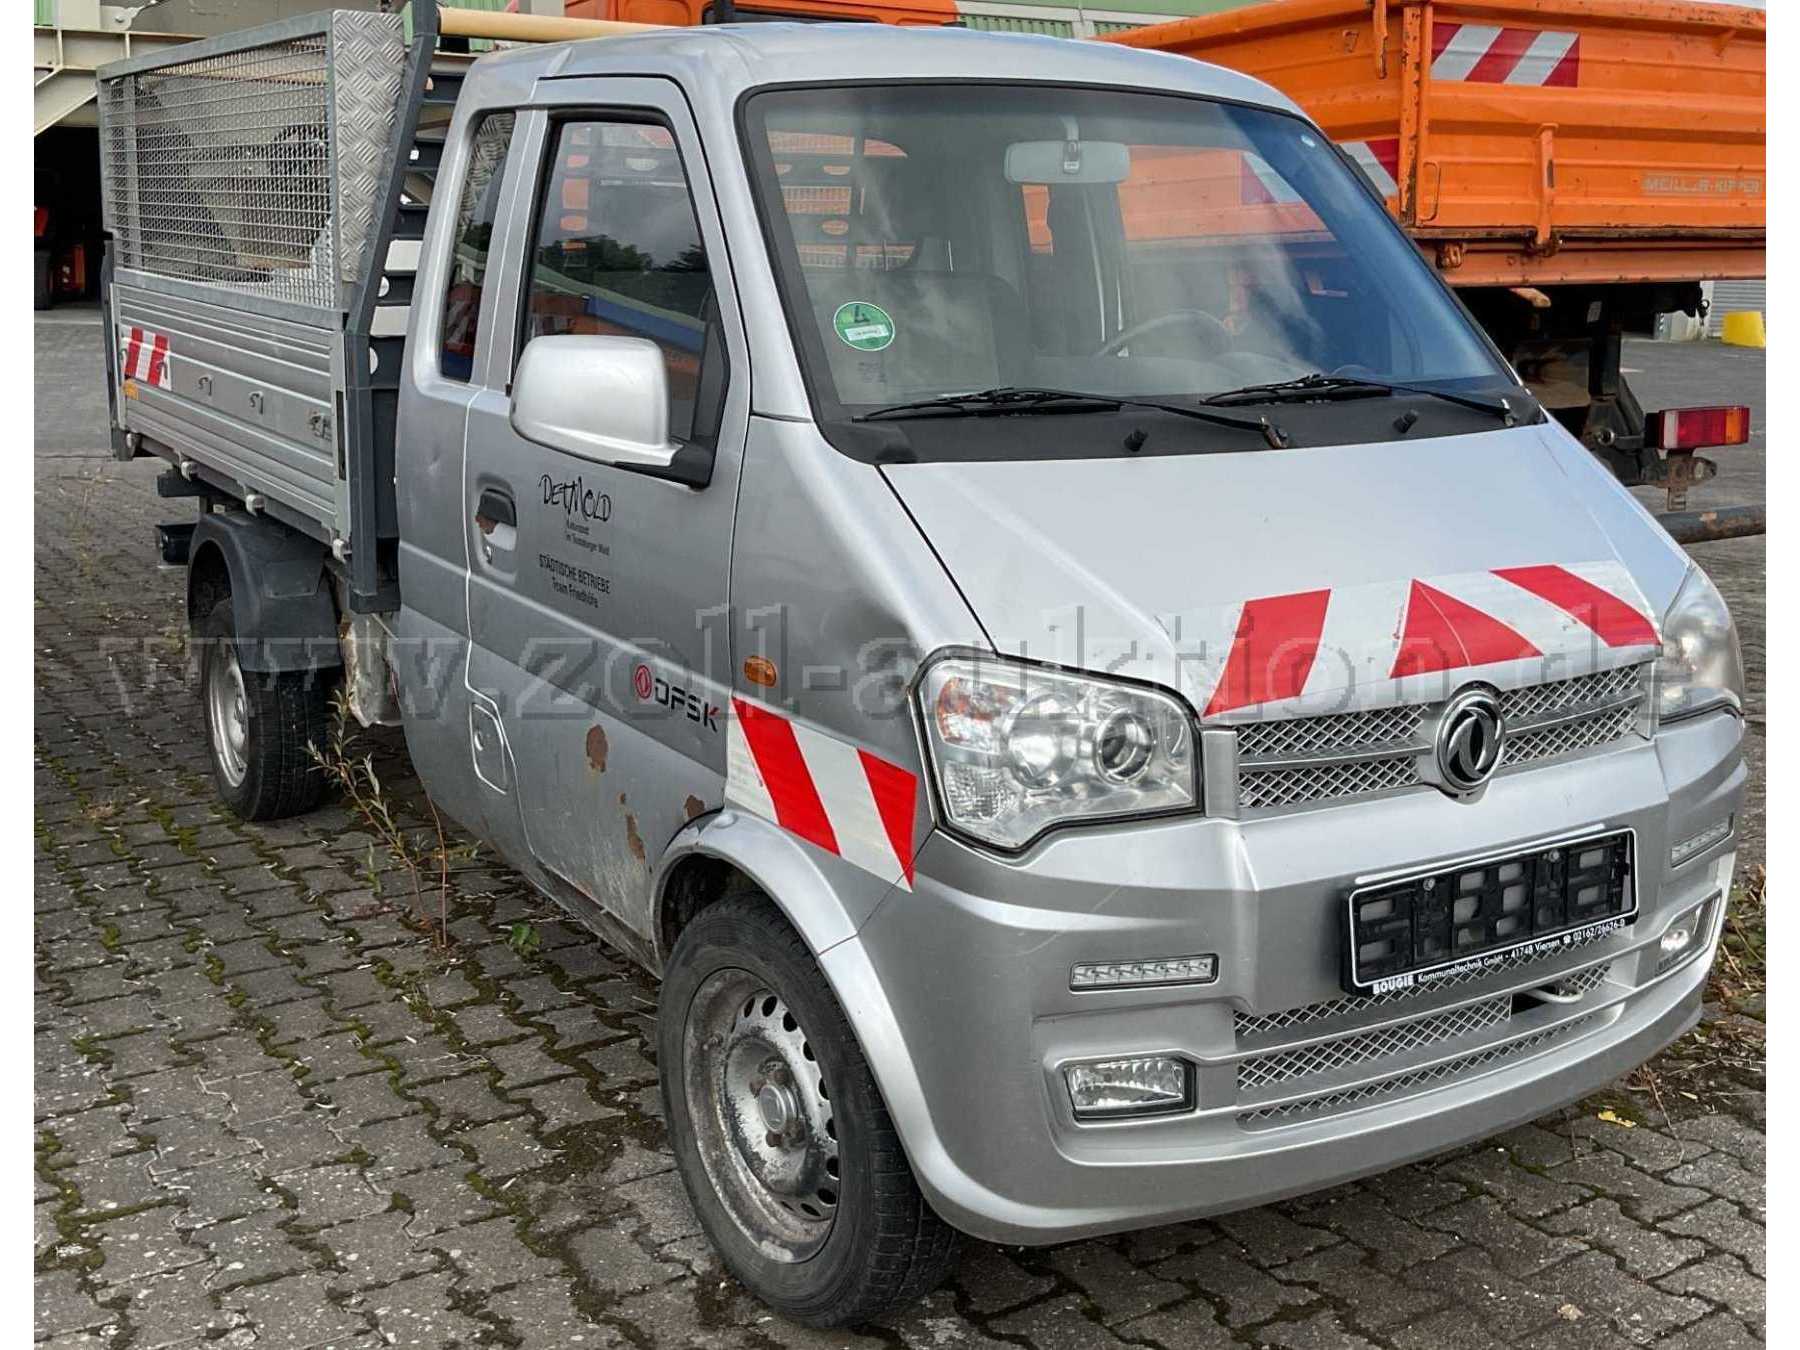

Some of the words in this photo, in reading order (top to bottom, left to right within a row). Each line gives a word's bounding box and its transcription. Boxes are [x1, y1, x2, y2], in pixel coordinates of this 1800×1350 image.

[538, 474, 612, 522] DETMOLD
[578, 569, 611, 595] BETRIEBE
[655, 677, 720, 733] DFSK
[1372, 975, 1414, 995] BOUGIE
[1418, 959, 1483, 983] Kommunaltechnik
[1511, 945, 1534, 959] 41748
[1534, 938, 1561, 952] Viersen
